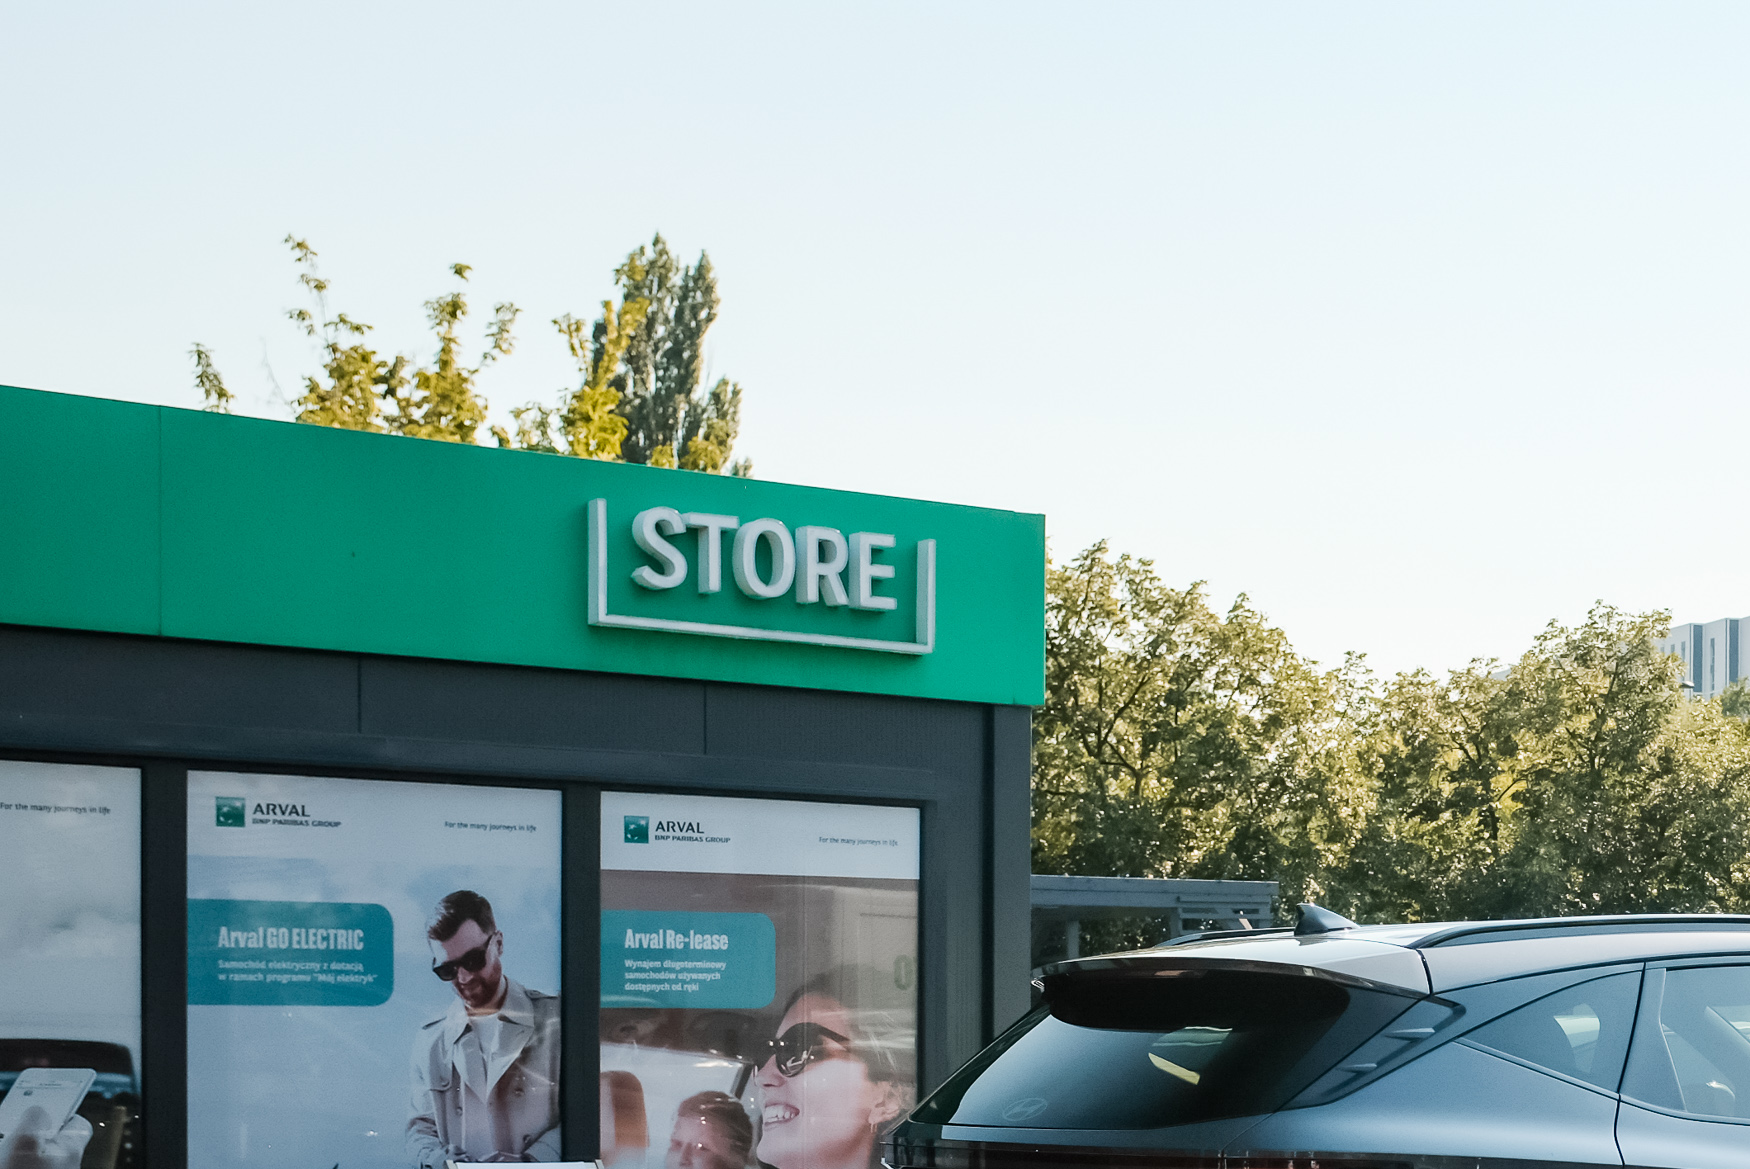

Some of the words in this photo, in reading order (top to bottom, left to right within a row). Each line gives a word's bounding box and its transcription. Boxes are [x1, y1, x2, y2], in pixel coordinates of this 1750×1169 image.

[631, 506, 898, 611] STORE
[15, 803, 28, 811] the
[30, 804, 52, 813] many
[253, 803, 311, 817] ARVAL
[457, 821, 468, 829] the
[655, 820, 705, 834] ARVAL
[705, 836, 731, 844] GROUP
[218, 926, 264, 948] Arval
[266, 927, 290, 949] GO
[291, 927, 365, 950] ELECTRIC
[624, 928, 664, 949] Arval
[666, 929, 729, 950] Re-lease
[624, 959, 662, 970] Wynajem
[624, 971, 677, 980] samochodów
[671, 982, 682, 991] od
